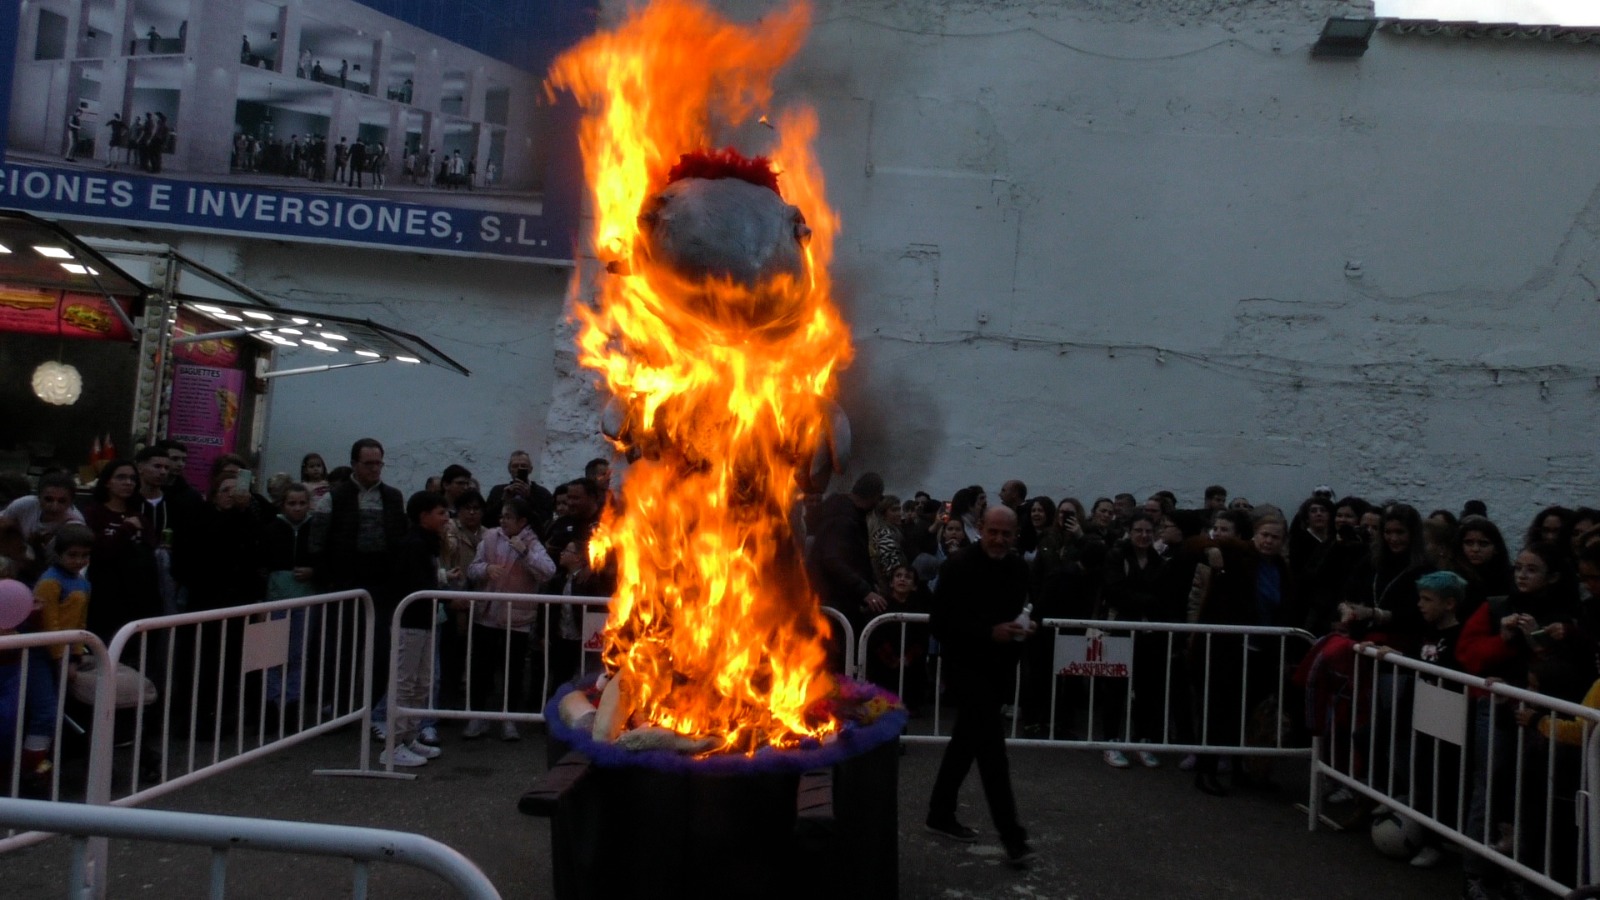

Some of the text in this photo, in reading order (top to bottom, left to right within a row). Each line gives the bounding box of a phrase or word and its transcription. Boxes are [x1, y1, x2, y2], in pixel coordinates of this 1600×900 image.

[0, 168, 547, 247] IONES E INVERSIONES, S.L.
